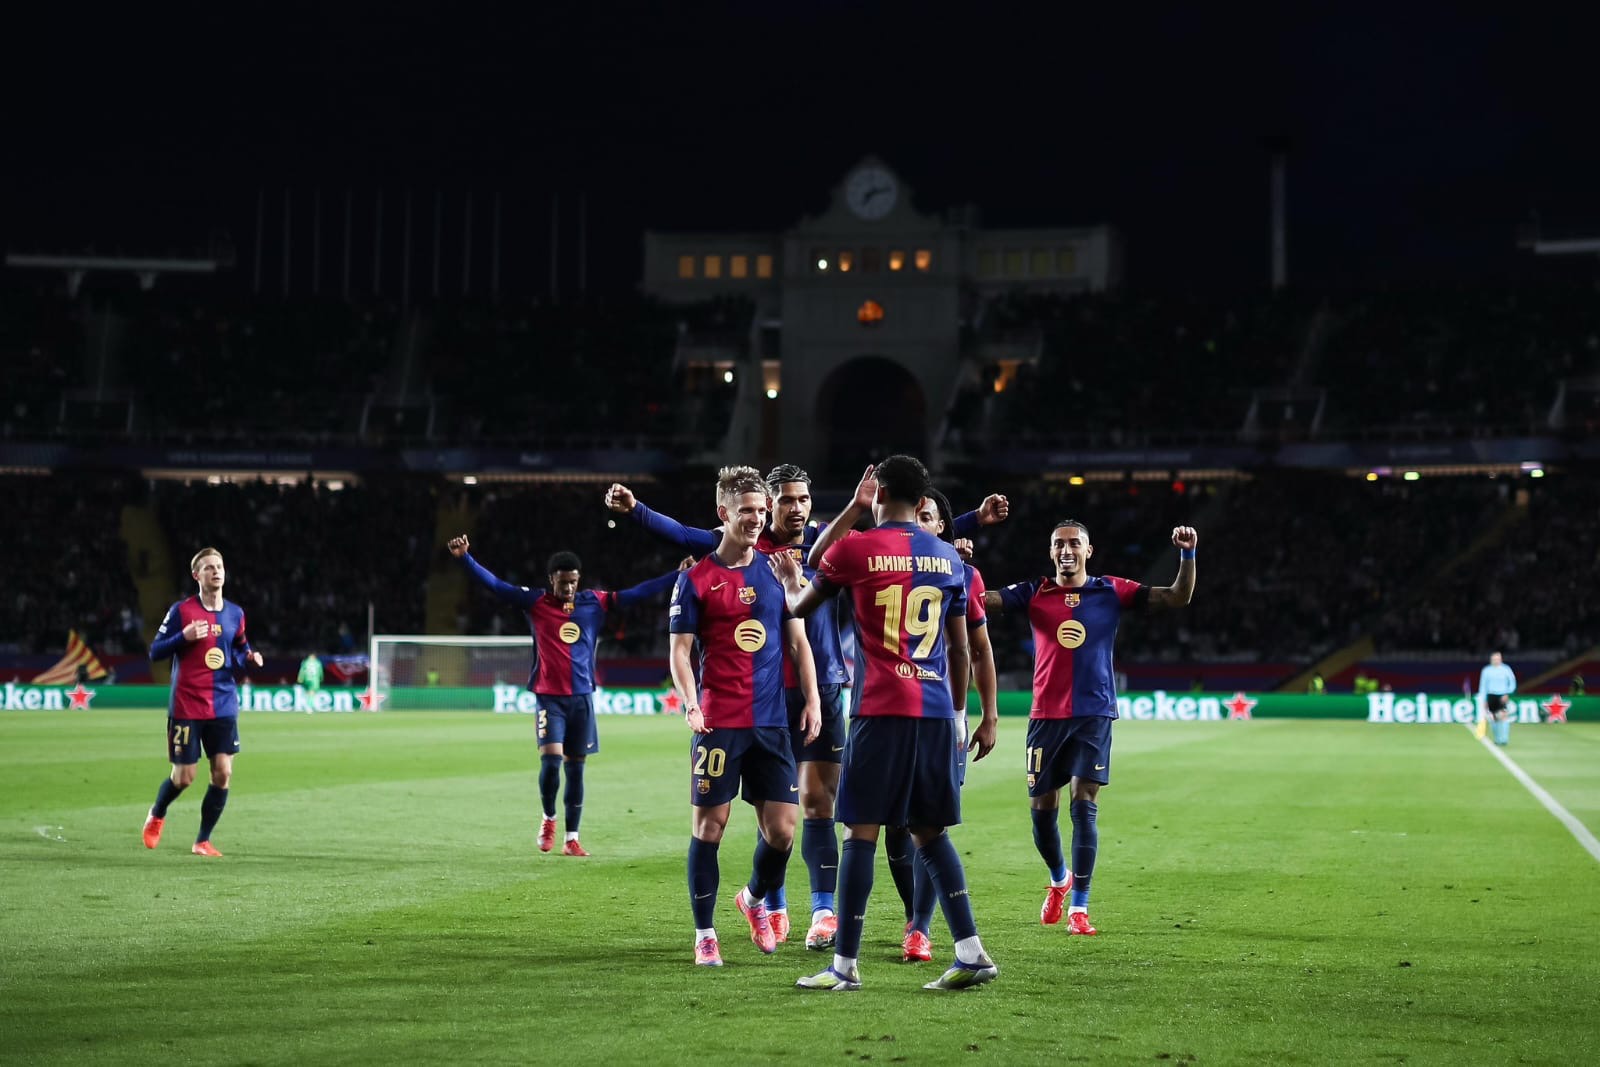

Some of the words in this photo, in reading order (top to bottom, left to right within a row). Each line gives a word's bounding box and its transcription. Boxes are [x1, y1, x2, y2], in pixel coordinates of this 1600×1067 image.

[867, 556, 913, 572] LAMINE
[915, 556, 953, 575] YAMAL
[875, 585, 943, 658] 19
[0, 682, 64, 710] ken
[238, 684, 353, 712] ineken
[538, 709, 548, 729] 3
[174, 725, 190, 745] 21
[693, 746, 726, 777] 20
[1027, 746, 1043, 773] 11
